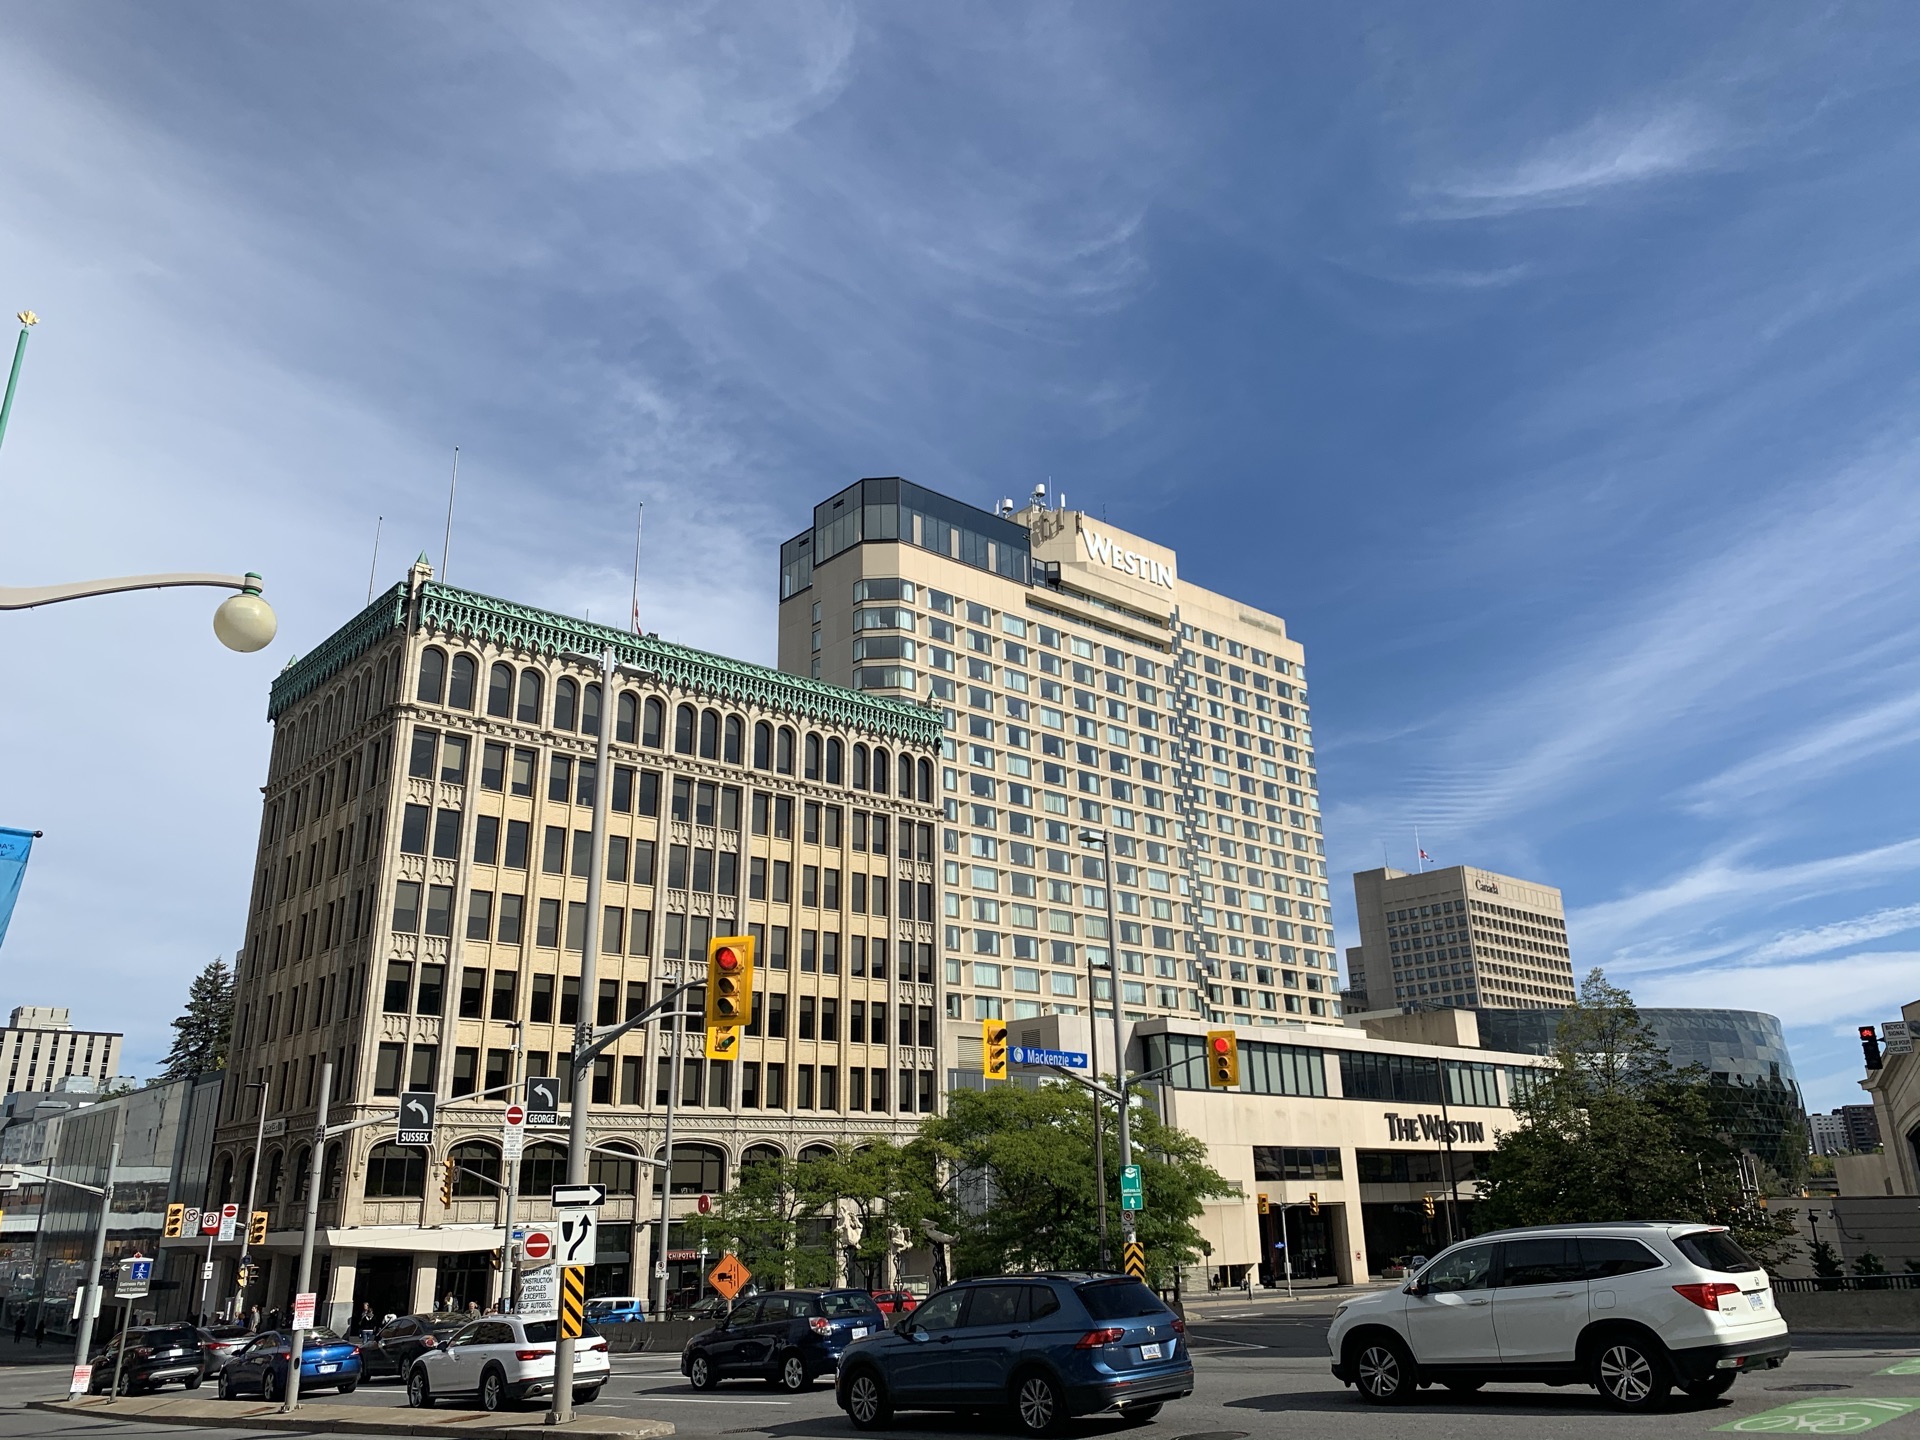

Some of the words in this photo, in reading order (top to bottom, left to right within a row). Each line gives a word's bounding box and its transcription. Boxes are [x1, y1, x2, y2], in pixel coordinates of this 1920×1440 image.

[1081, 528, 1173, 590] WESTIN
[1475, 879, 1499, 895] Canada
[1027, 1049, 1070, 1067] Mackenzie
[528, 1113, 556, 1124] GEORGE
[1384, 1112, 1421, 1142] THE
[1417, 1113, 1485, 1144] WESTIN
[400, 1131, 430, 1142] SUSSEX
[668, 1252, 696, 1260] CHIPOTLE
[542, 1268, 553, 1276] AND
[525, 1284, 547, 1292] VEHICLES
[523, 1292, 547, 1300] EXCEPTED
[517, 1302, 530, 1310] SAUF
